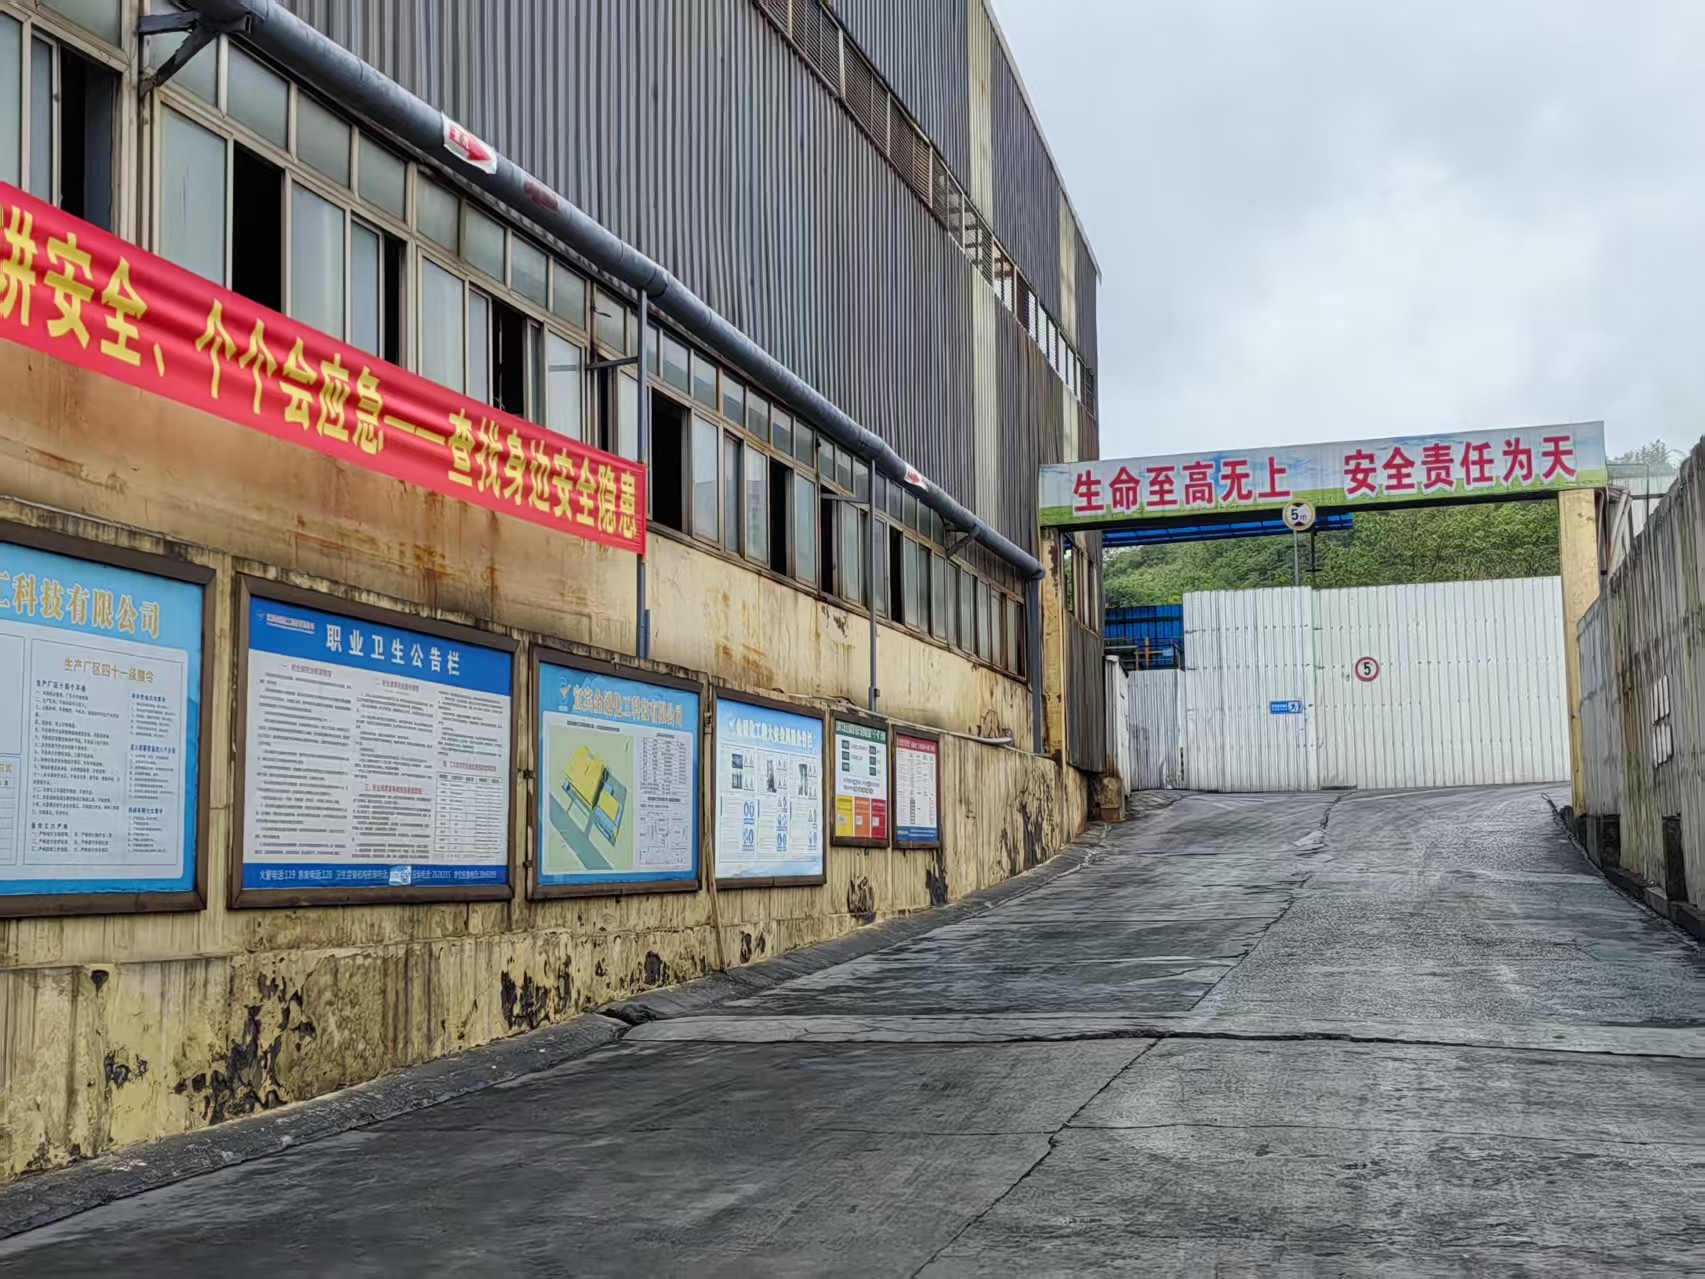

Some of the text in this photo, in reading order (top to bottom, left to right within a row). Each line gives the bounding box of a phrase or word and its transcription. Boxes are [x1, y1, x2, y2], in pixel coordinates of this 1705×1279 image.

[1072, 434, 1578, 516] 生命至高无上 安全责任为天
[325, 623, 460, 676] 职业卫生公告栏
[1363, 661, 1371, 677] 5
